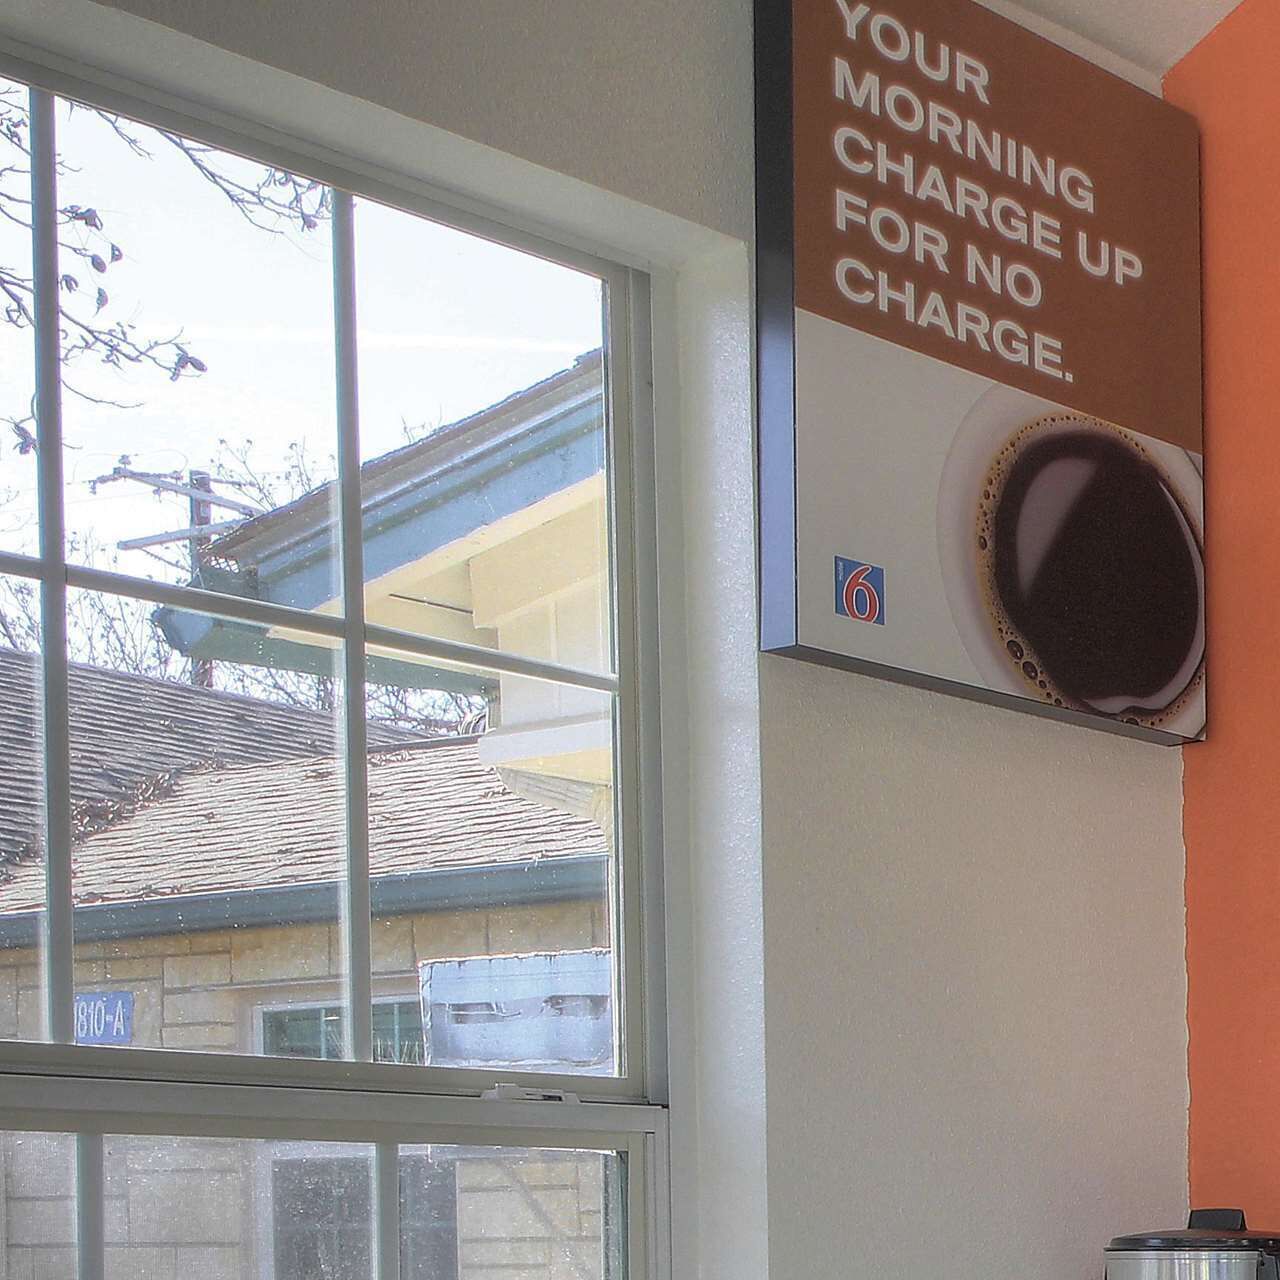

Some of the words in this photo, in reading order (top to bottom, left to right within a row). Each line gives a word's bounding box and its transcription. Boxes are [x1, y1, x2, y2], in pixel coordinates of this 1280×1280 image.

[836, 0, 991, 105] YOUR
[835, 56, 1096, 214] MORNING
[834, 126, 1063, 260] CHARGE
[1078, 231, 1144, 286] UP
[835, 189, 950, 274] FOR
[967, 244, 1043, 307] NO
[834, 257, 1074, 383] CHARGE.
[843, 565, 880, 624] 6
